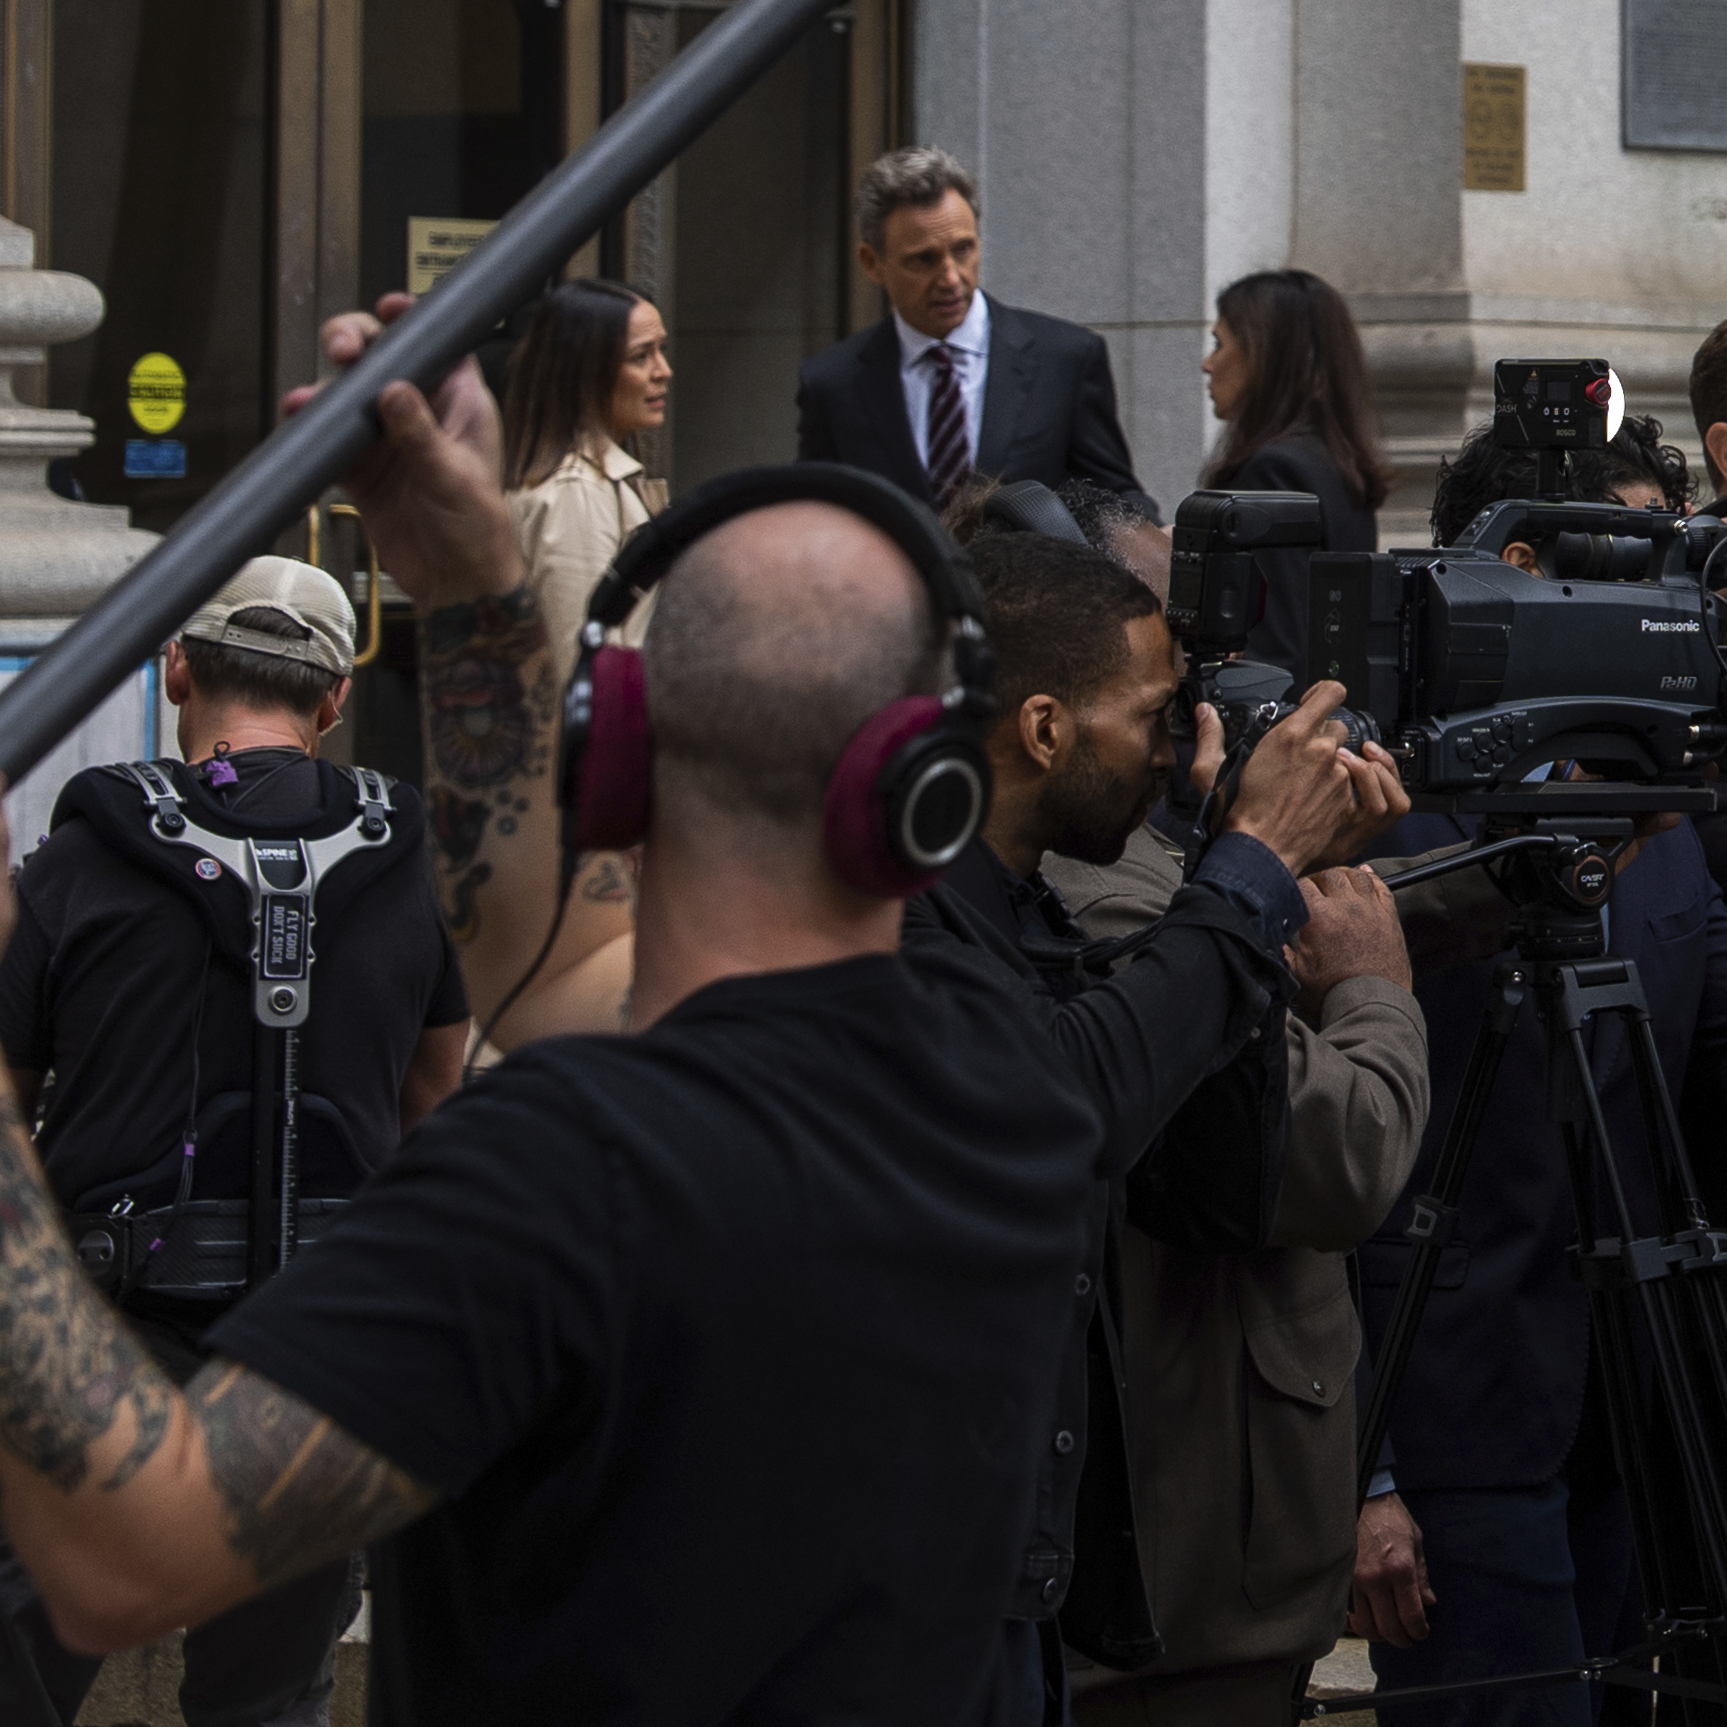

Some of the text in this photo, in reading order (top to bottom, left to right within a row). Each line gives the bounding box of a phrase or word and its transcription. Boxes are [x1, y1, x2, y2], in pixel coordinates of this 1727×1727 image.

[1641, 619, 1700, 632] Panasonic
[285, 910, 299, 961] FLY GOOD
[270, 936, 284, 963] SUCK
